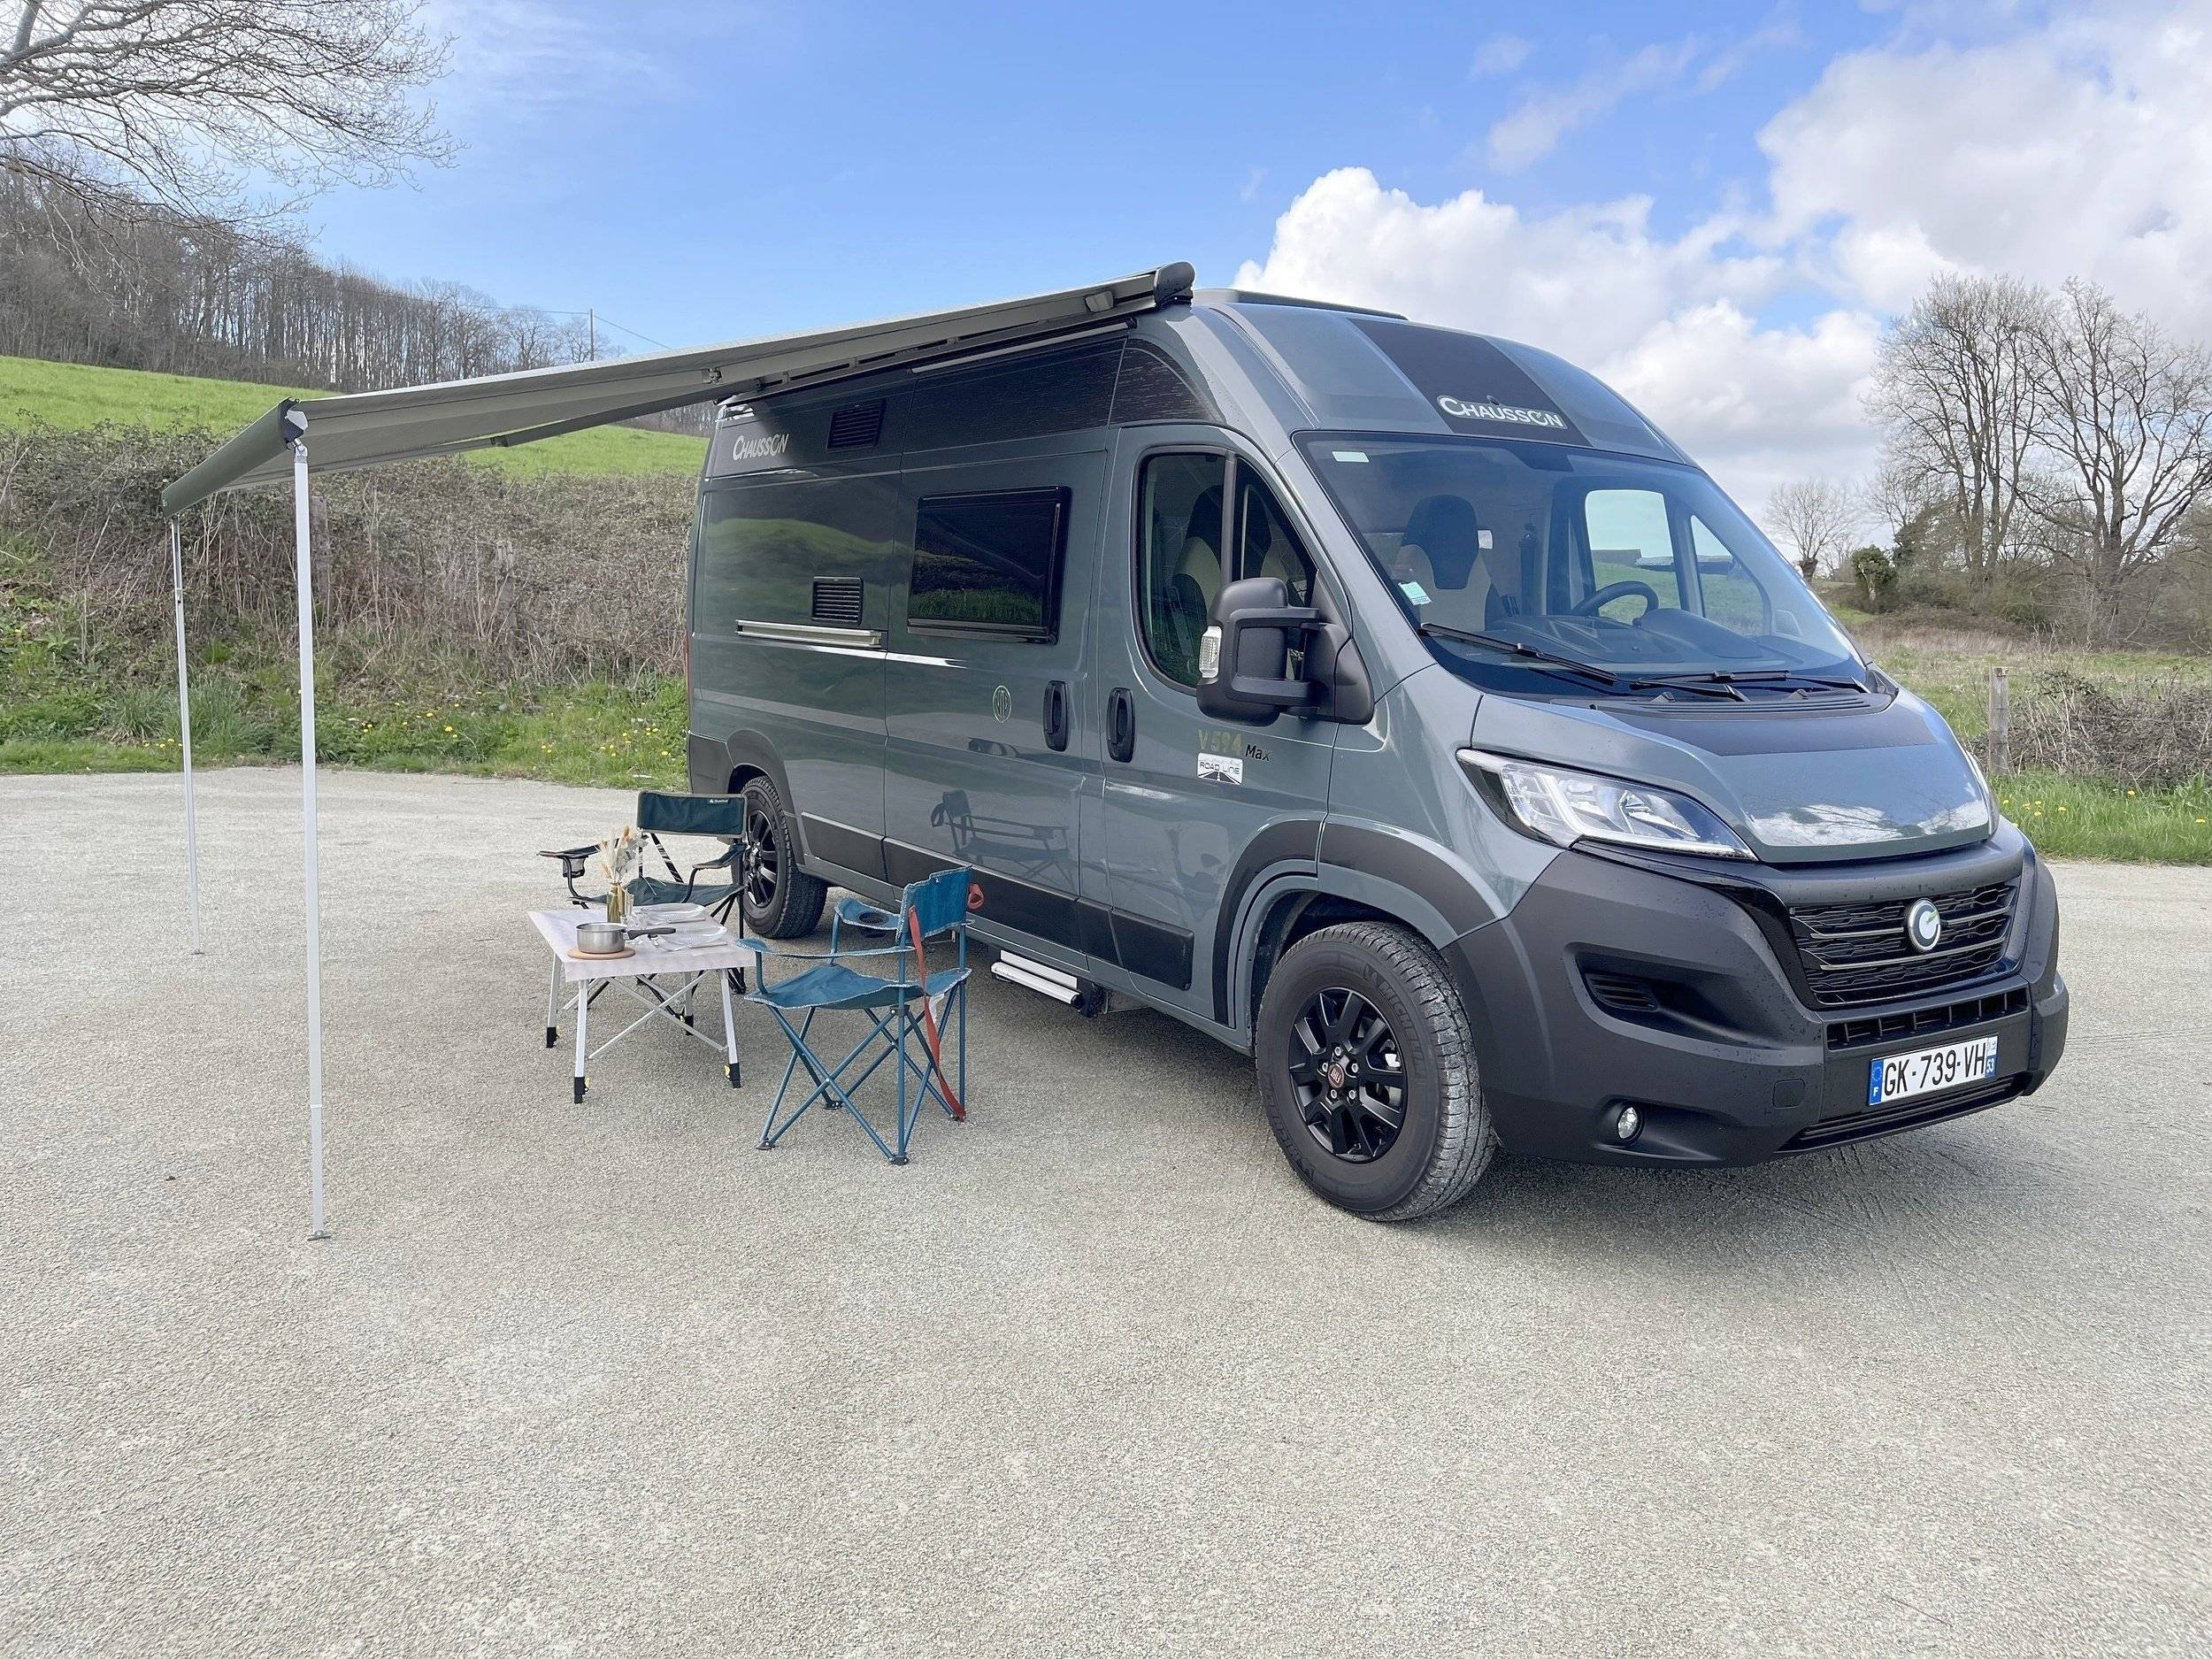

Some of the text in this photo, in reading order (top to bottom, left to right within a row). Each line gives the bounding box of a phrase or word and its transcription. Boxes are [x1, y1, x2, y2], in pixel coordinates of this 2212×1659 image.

[1245, 744, 1271, 762] Max
[1199, 761, 1220, 772] ROAD
[1884, 1042, 1986, 1096] GK-739-VH
[1986, 1057, 1995, 1073] 53
[1872, 1087, 1879, 1097] F
